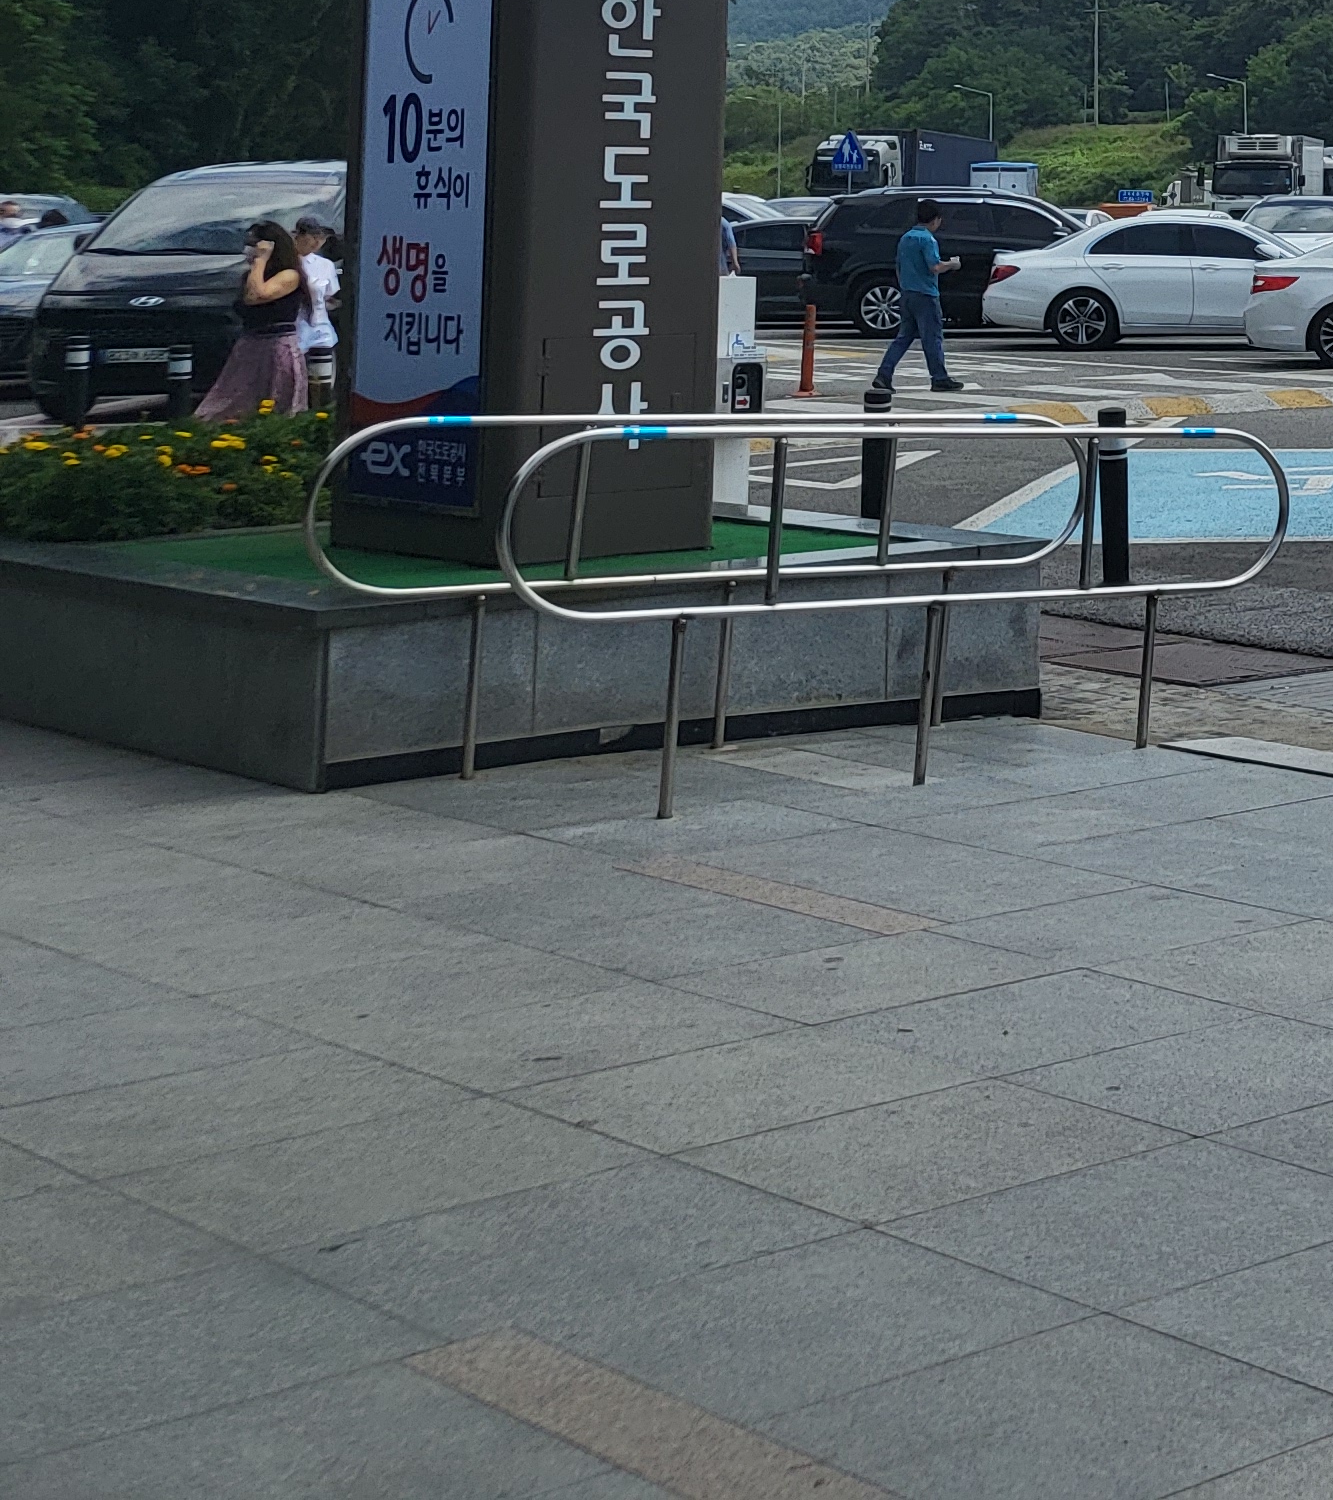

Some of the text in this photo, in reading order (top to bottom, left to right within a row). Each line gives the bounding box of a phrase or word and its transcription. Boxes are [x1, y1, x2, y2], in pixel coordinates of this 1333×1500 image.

[383, 92, 466, 164] 10분의
[413, 164, 470, 211] 휴식이
[377, 235, 449, 303] 생명을
[384, 311, 464, 356] 지킵니다
